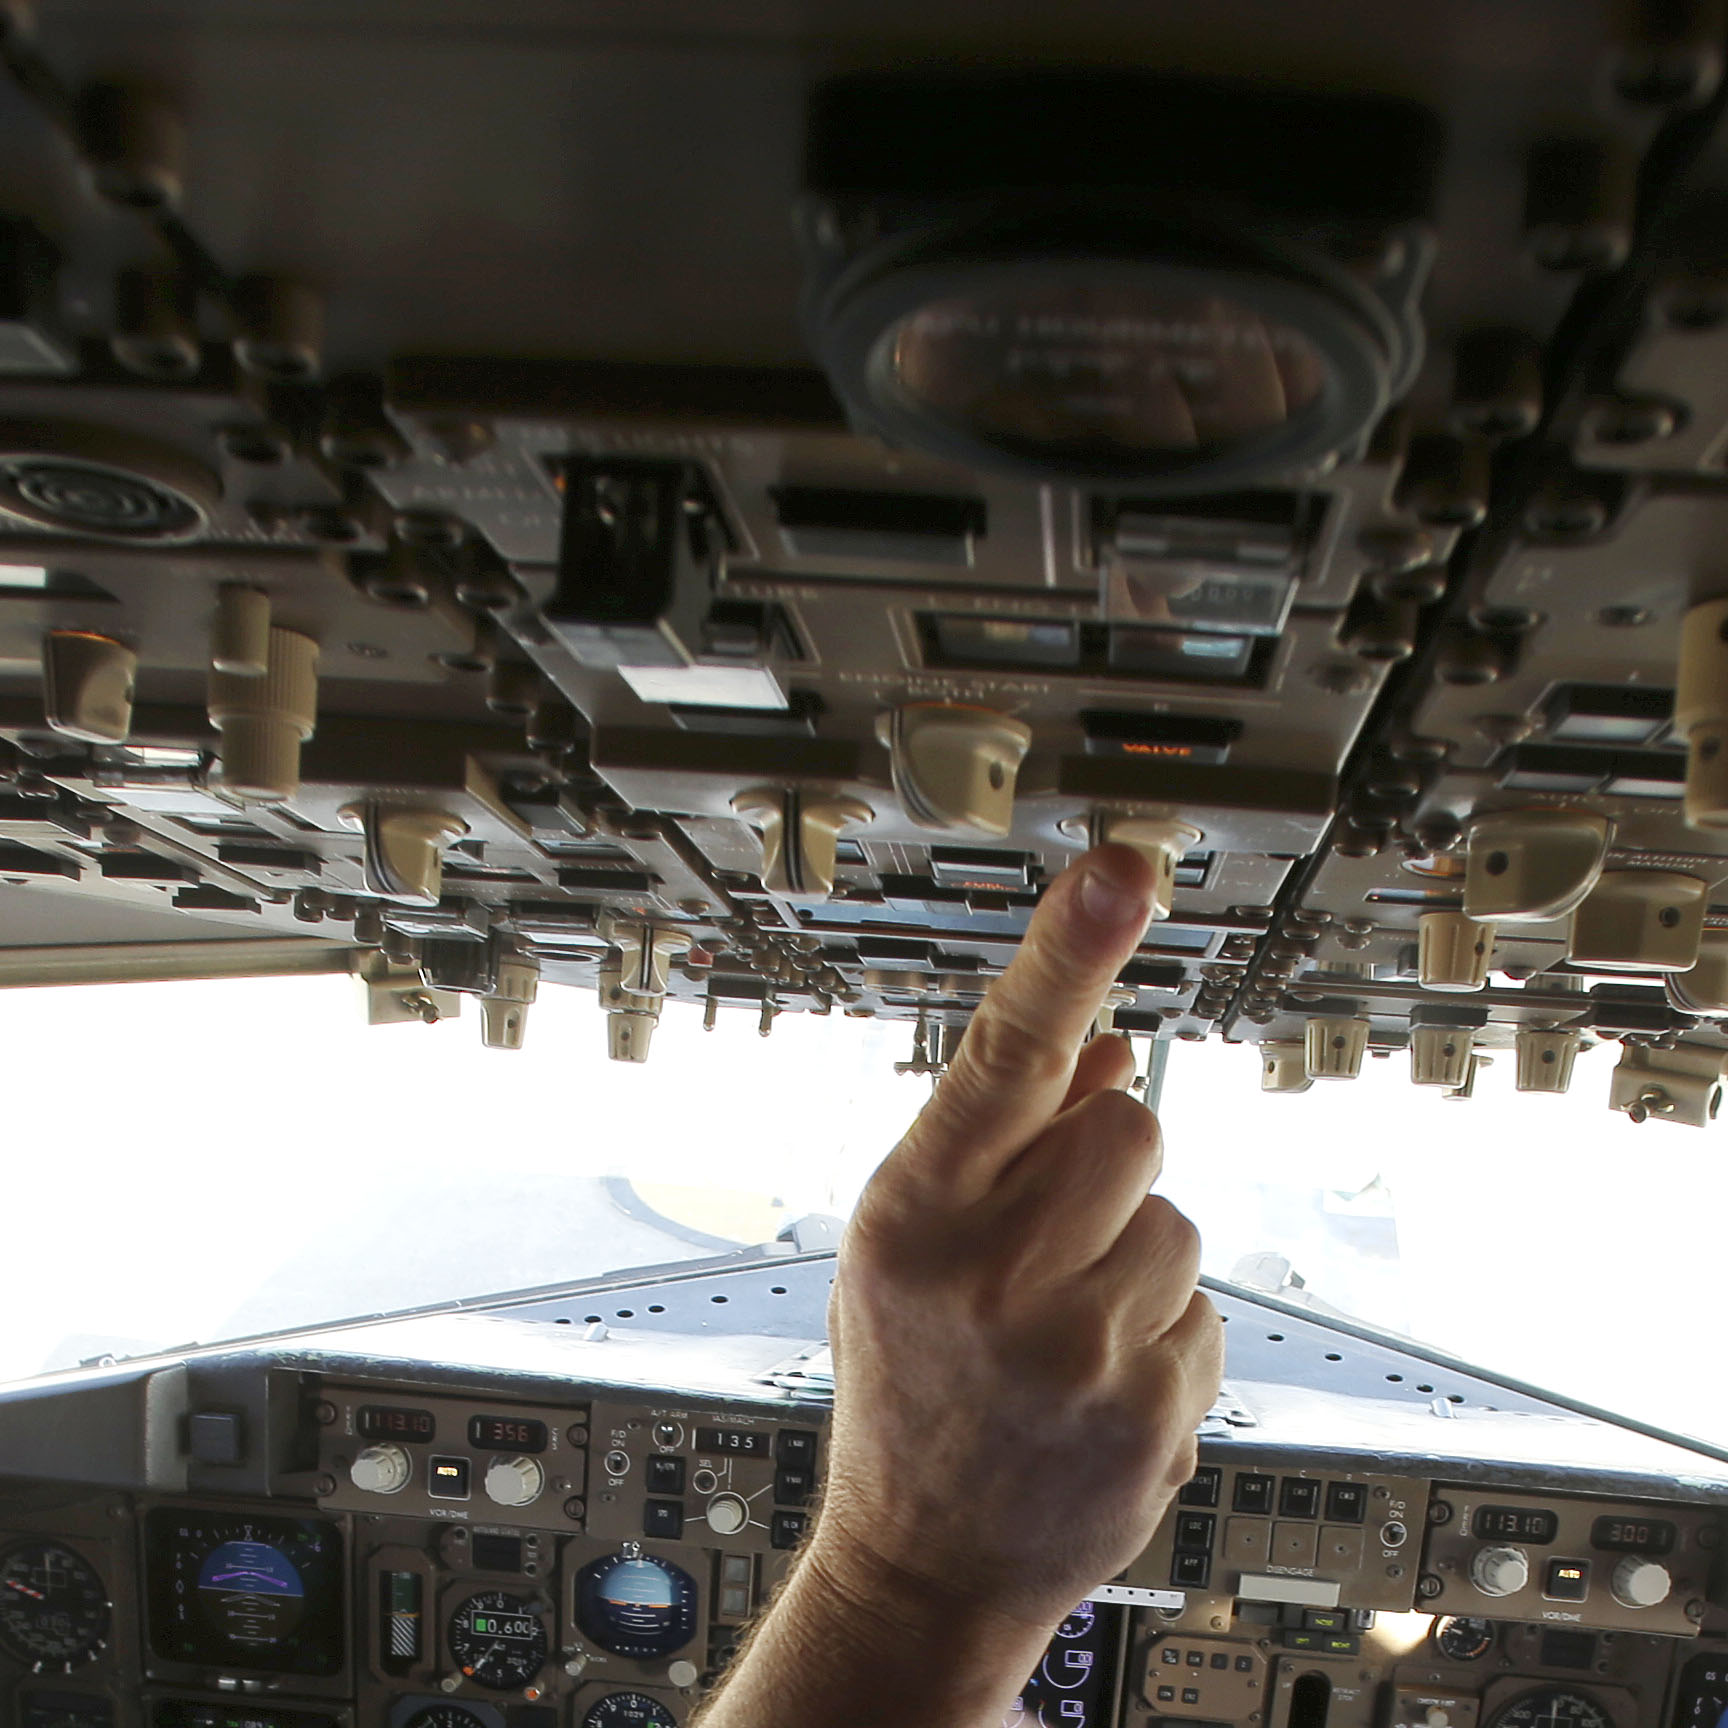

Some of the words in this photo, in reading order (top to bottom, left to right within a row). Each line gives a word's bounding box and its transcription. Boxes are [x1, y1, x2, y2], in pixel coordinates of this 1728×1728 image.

[1123, 742, 1192, 757] VALVE
[493, 1424, 528, 1442] 356
[718, 1433, 753, 1448] 135
[611, 1438, 625, 1447] ON
[1610, 1524, 1648, 1544] 300
[1266, 1565, 1315, 1577] DISENGAGE
[630, 1700, 638, 1708] 0
